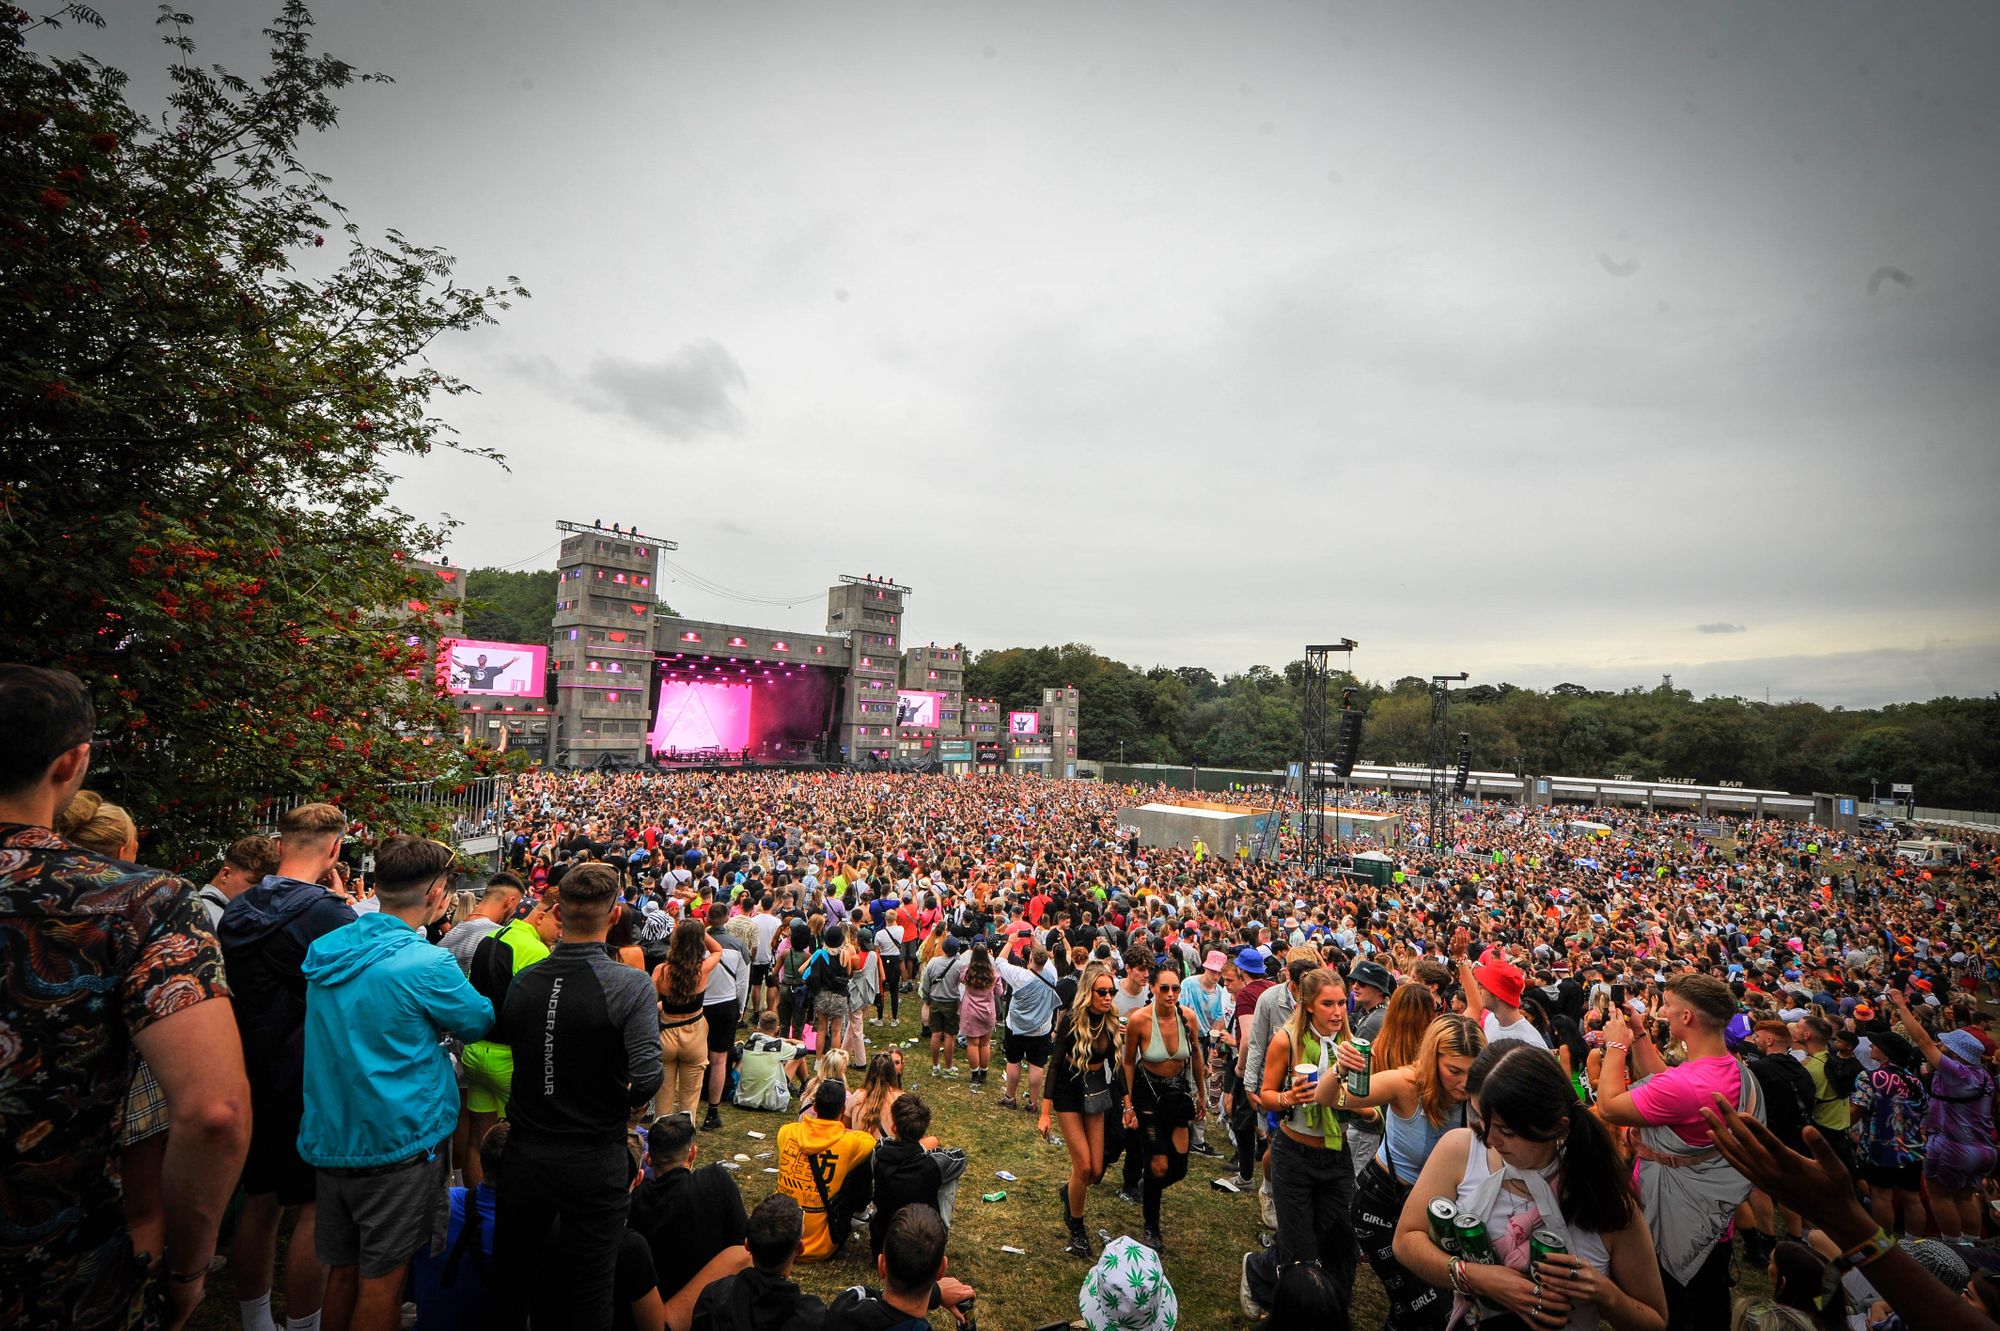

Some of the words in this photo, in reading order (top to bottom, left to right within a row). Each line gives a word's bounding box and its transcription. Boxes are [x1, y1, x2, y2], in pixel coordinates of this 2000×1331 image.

[1359, 759, 1375, 767] THE
[1718, 780, 1743, 788] BAR
[545, 977, 563, 1030] UNDER
[544, 1031, 554, 1096] ARMOUR
[1362, 1212, 1393, 1229] GIRLS
[1410, 1288, 1438, 1311] GIRLS
